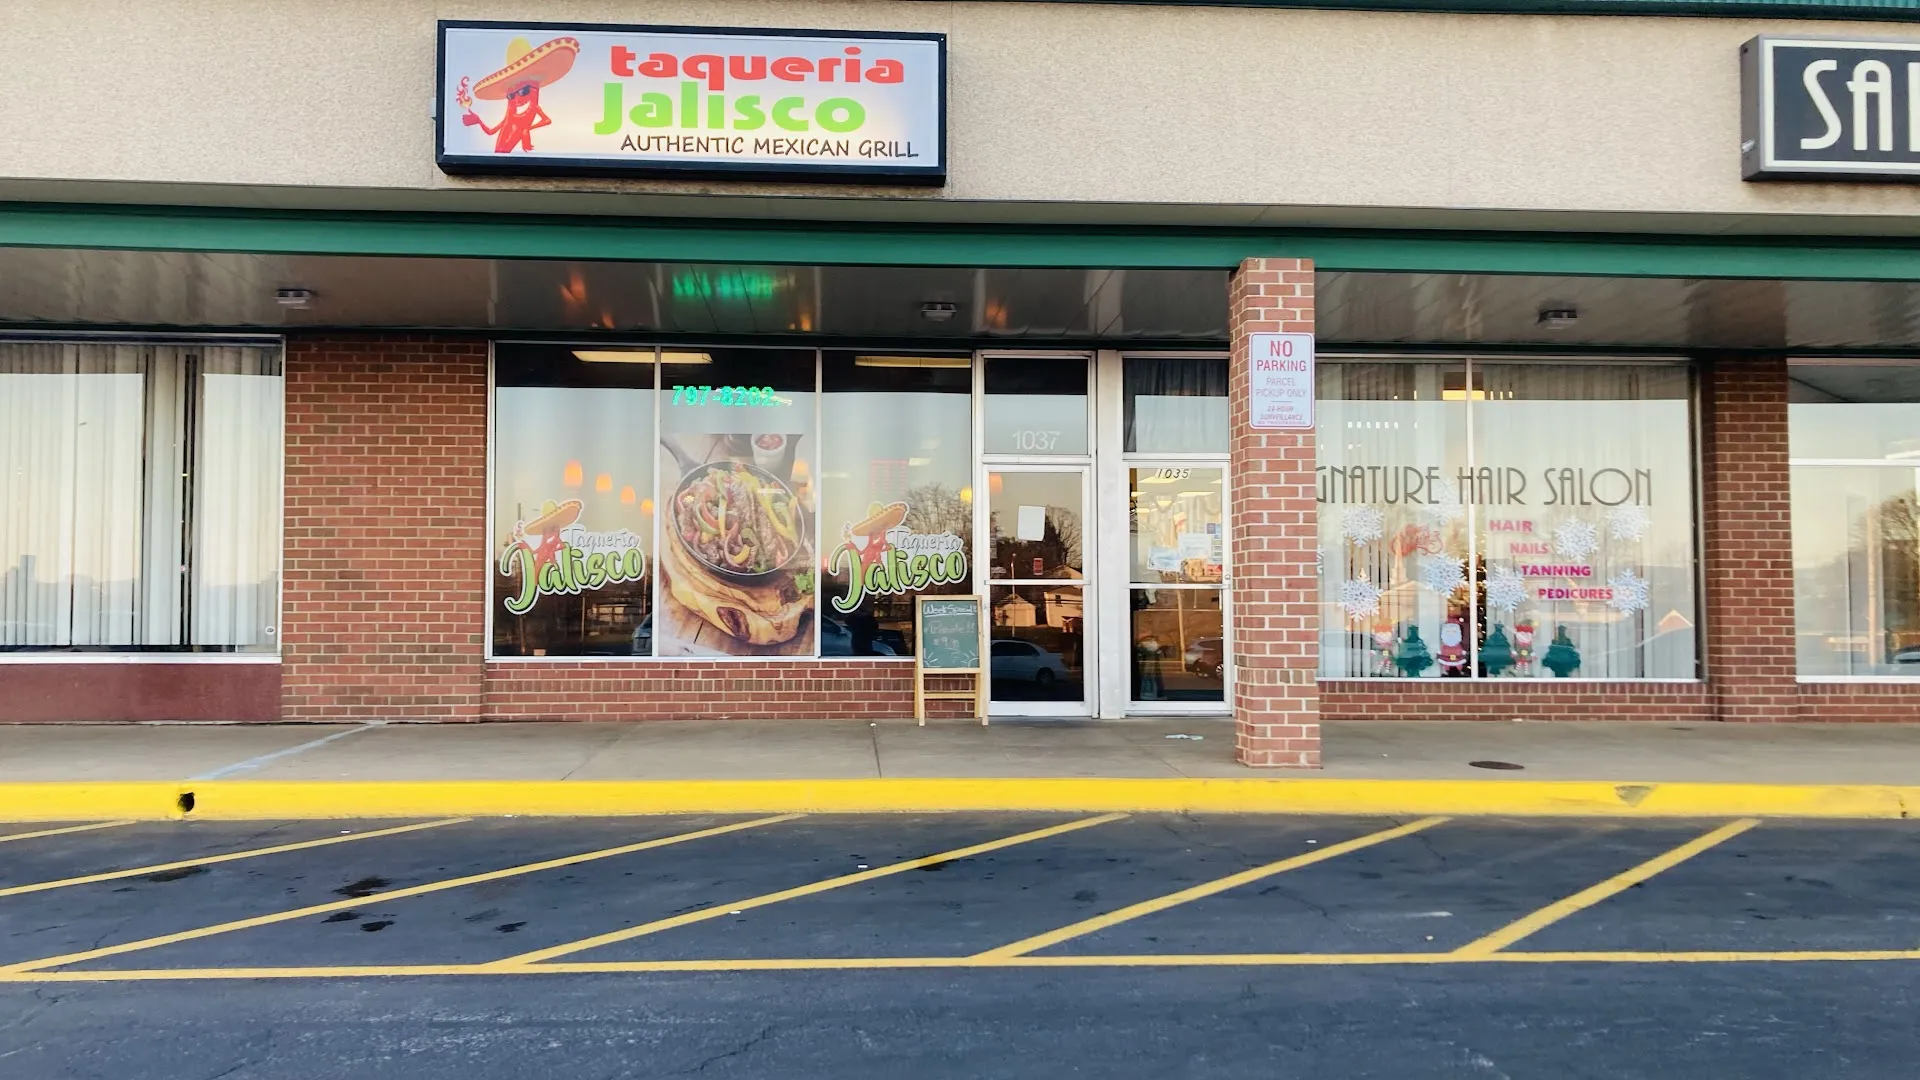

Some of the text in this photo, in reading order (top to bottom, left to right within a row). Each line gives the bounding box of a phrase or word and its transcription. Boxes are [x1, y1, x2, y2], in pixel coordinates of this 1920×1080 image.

[611, 46, 904, 90] taqueria
[594, 81, 866, 134] Jalisco
[620, 135, 919, 159] AUTHENTIC MEXICAN GRILL
[1270, 340, 1293, 357] NO
[1256, 360, 1307, 371] PARKING
[1266, 377, 1296, 386] PARCEL
[1256, 388, 1307, 398] PICKUP ONLY
[1012, 430, 1062, 450] 1037
[1156, 468, 1190, 479] 1035
[1457, 467, 1527, 505] HAIR
[1543, 467, 1653, 506] SALON
[1489, 519, 1533, 532] HAIR
[1509, 543, 1549, 554] NAILS
[502, 541, 644, 611] Jalisco
[830, 542, 966, 611] Jalisco
[1521, 565, 1592, 577] TANNING
[1538, 588, 1614, 599] PEDICURES
